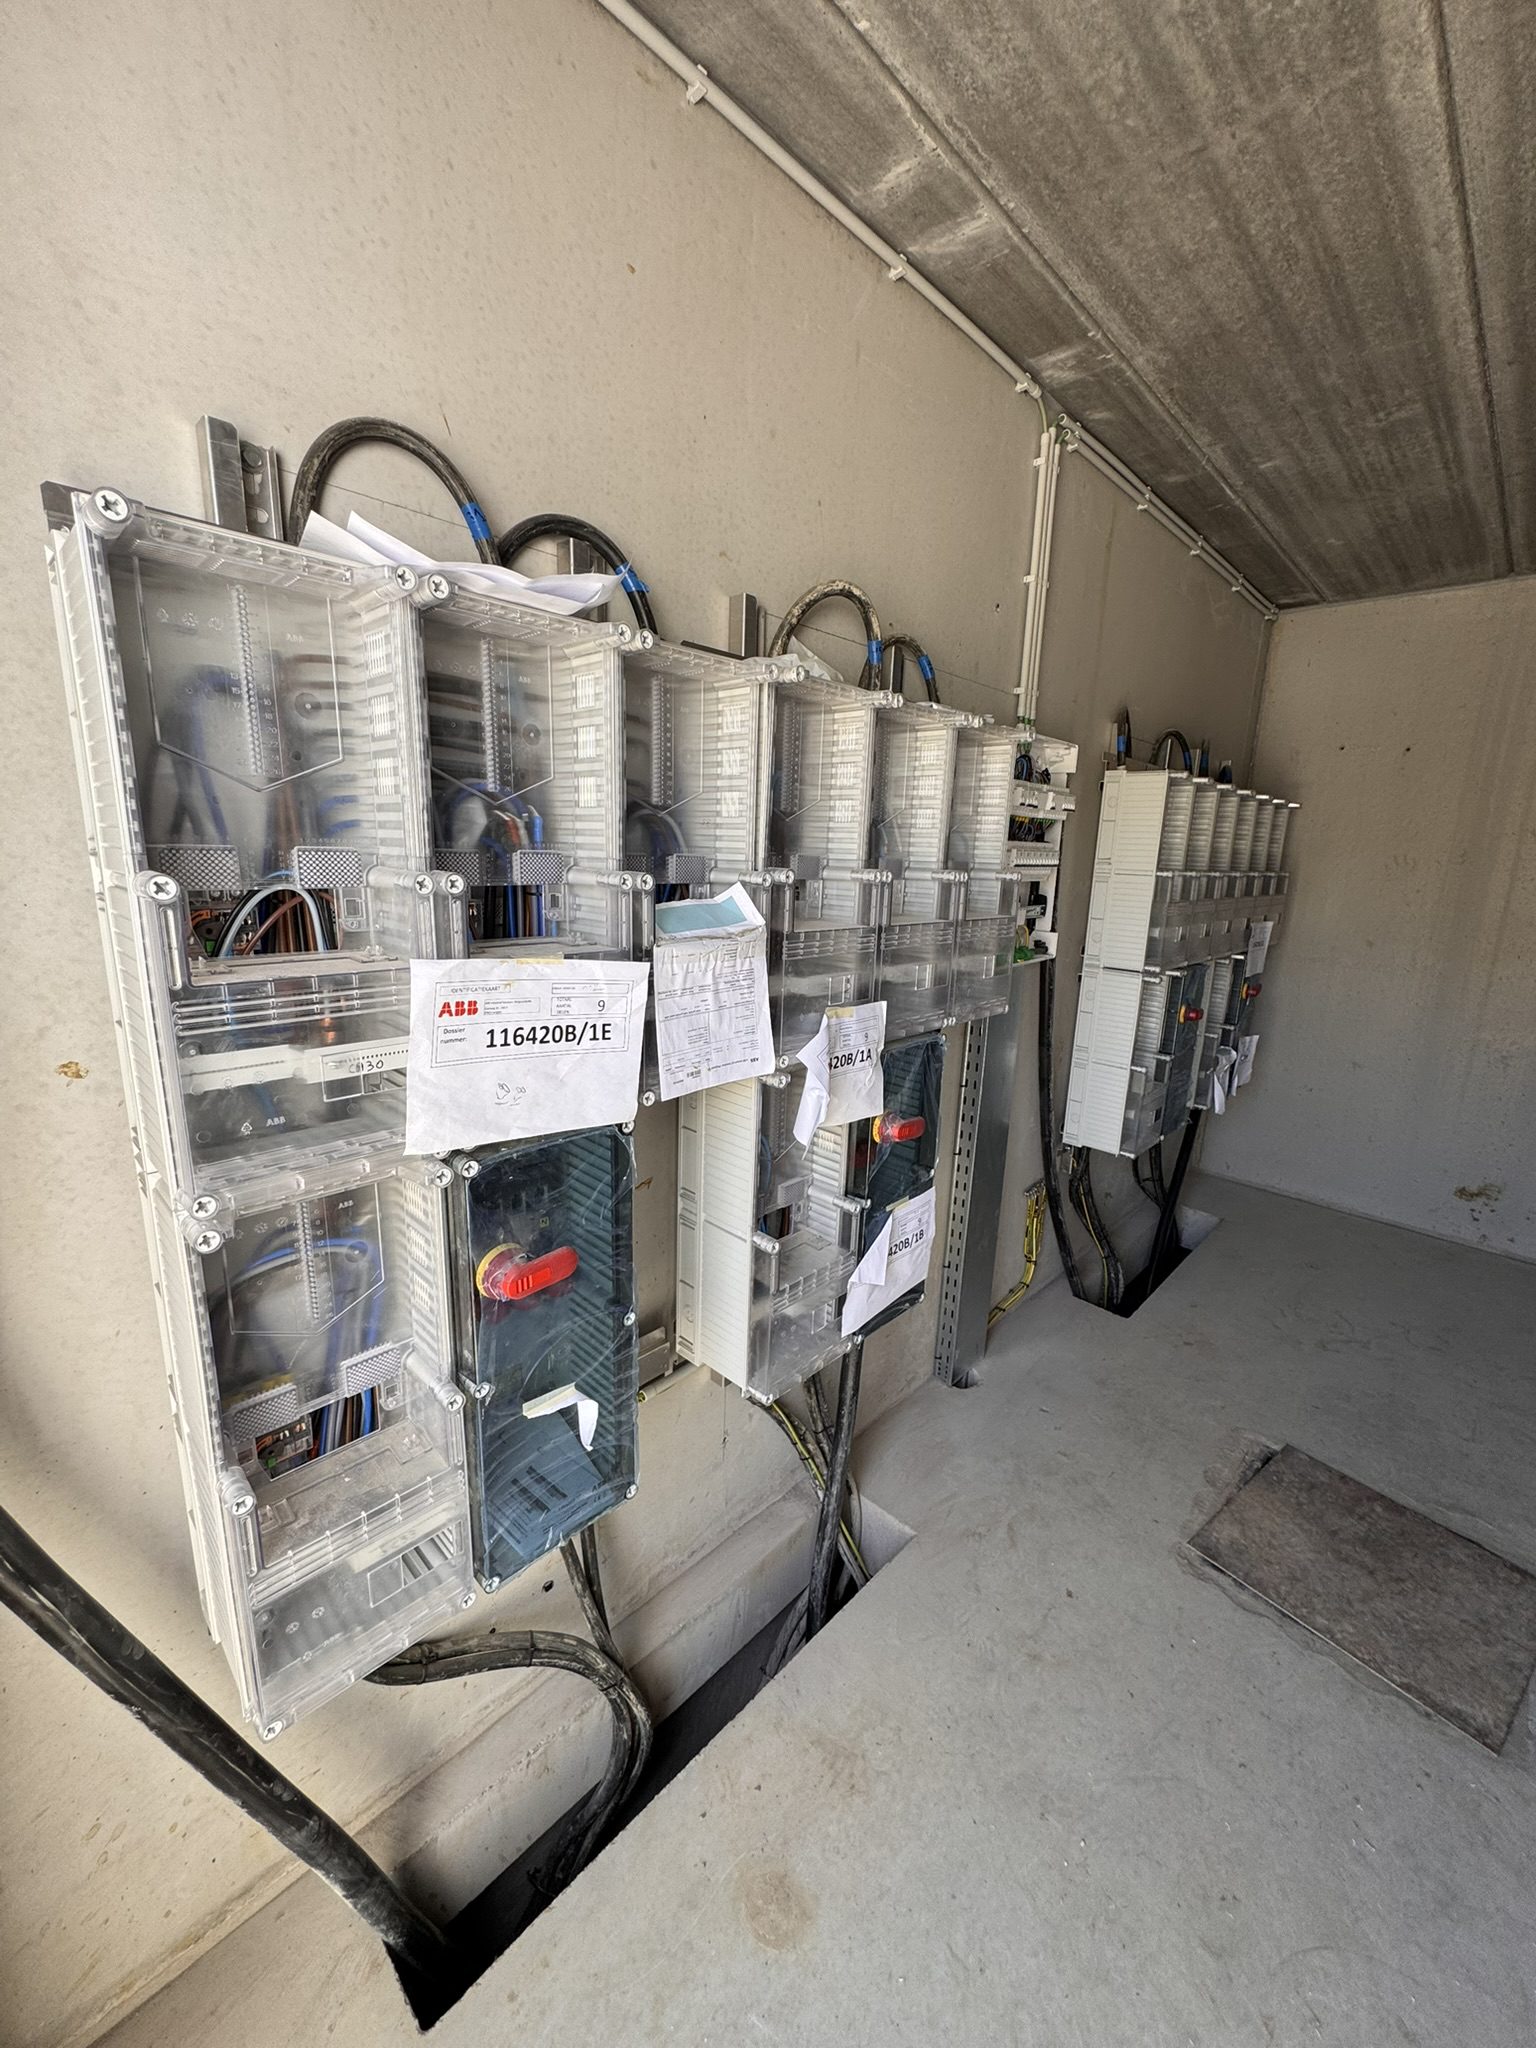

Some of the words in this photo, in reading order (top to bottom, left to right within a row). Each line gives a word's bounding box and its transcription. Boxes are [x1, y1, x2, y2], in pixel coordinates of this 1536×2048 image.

[438, 1000, 479, 1018] ABB
[597, 999, 606, 1012] 9
[443, 1027, 466, 1035] Dossier
[486, 1021, 613, 1049] 116420B/1E
